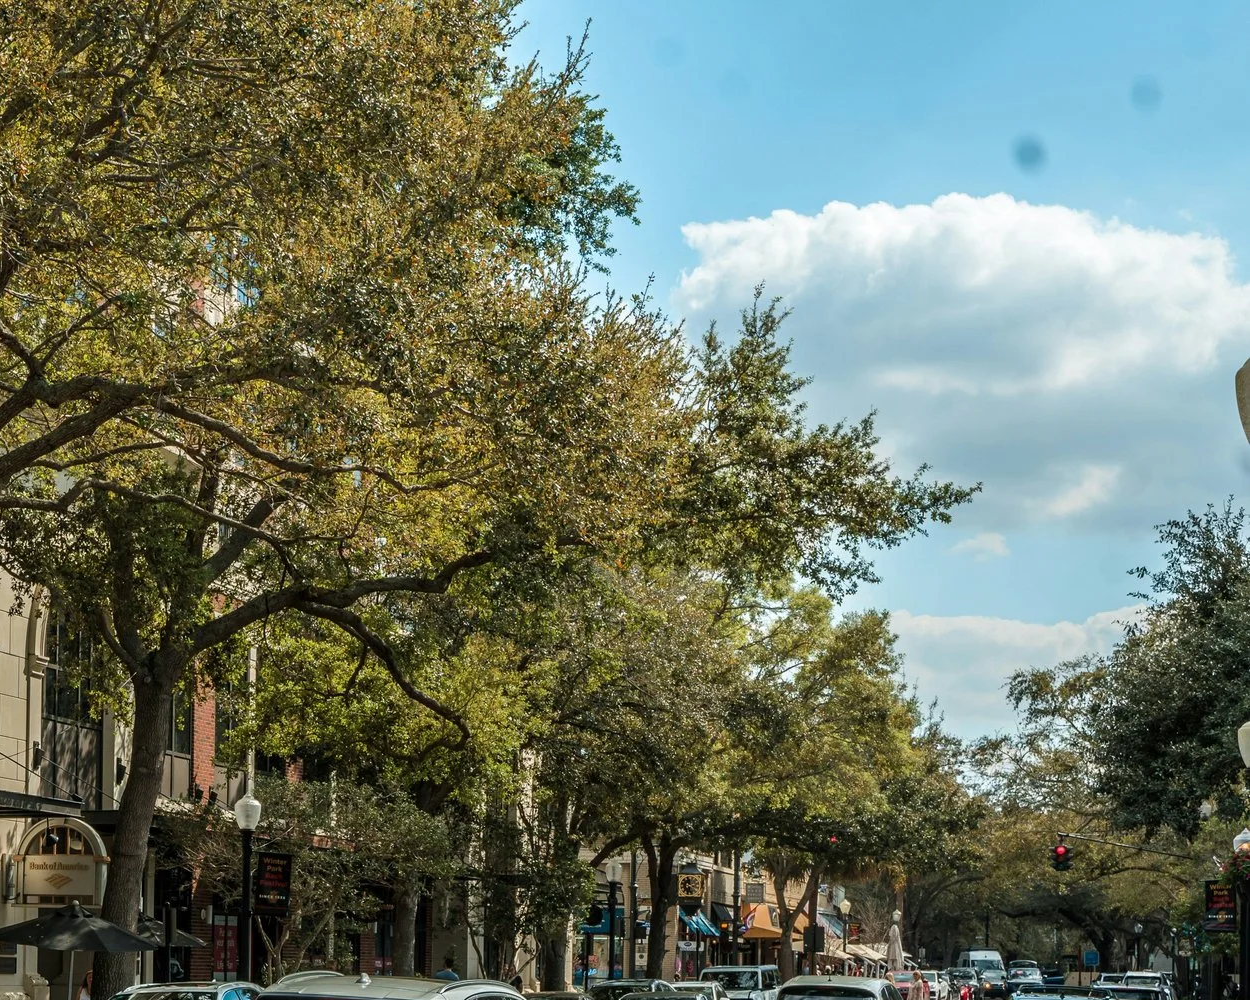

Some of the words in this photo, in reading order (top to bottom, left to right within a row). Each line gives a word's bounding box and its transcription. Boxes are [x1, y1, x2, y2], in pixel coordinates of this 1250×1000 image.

[29, 862, 48, 870] Bank
[49, 862, 56, 870] of
[57, 862, 90, 871] America
